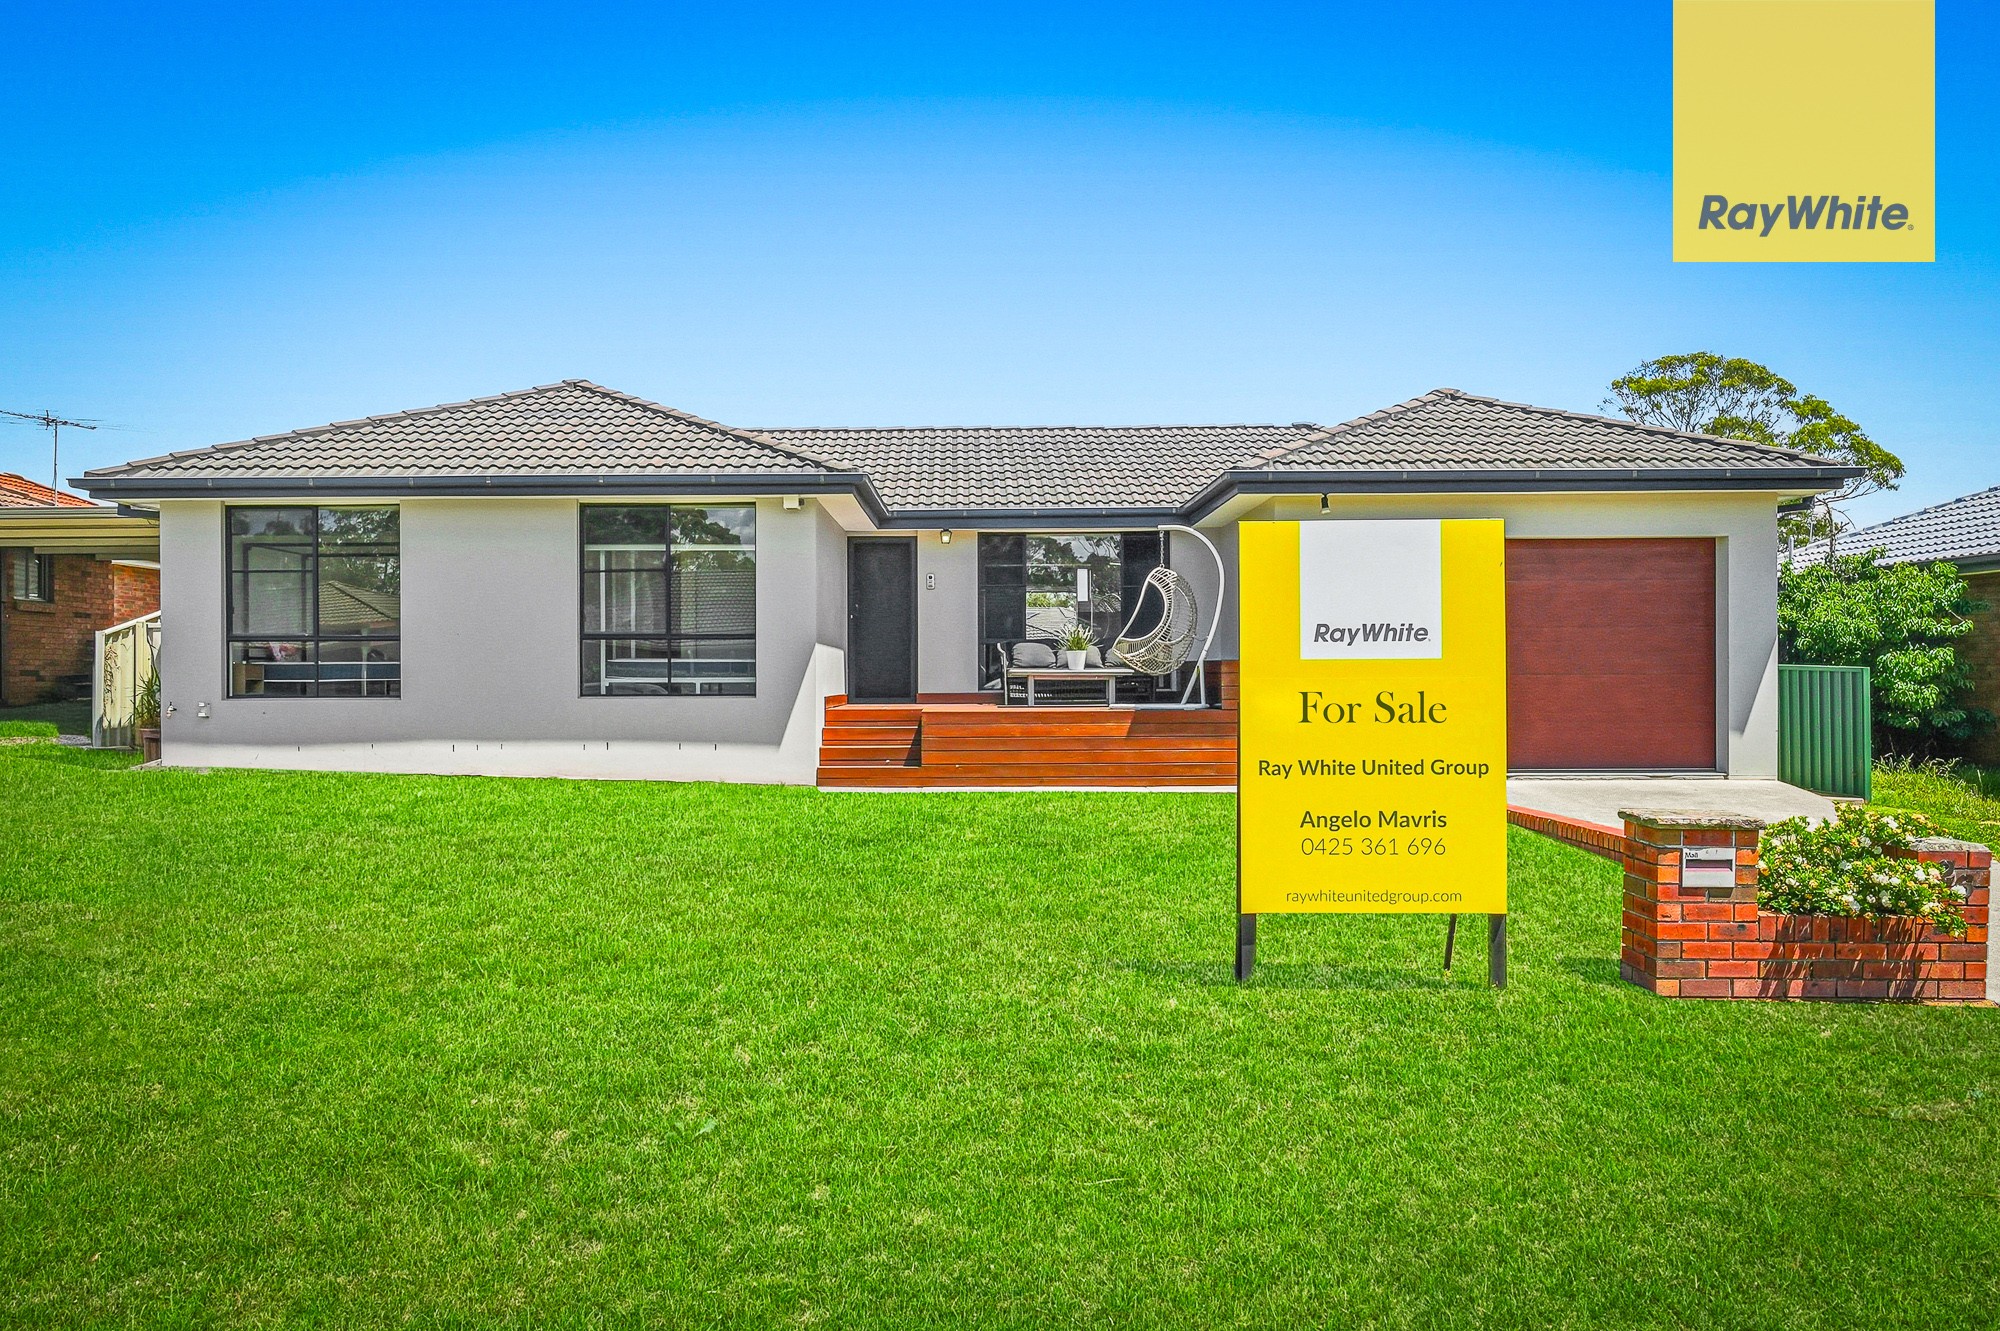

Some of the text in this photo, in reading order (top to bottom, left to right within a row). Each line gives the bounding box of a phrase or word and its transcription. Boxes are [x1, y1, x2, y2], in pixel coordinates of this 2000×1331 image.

[1298, 690, 1448, 724] For Sale
[1258, 758, 1490, 779] Ray White United Group
[1300, 809, 1448, 832] Angelo Mavris
[1301, 837, 1446, 856] 0425 361 696
[1286, 889, 1462, 906] raywhiteunitedgroup.com
